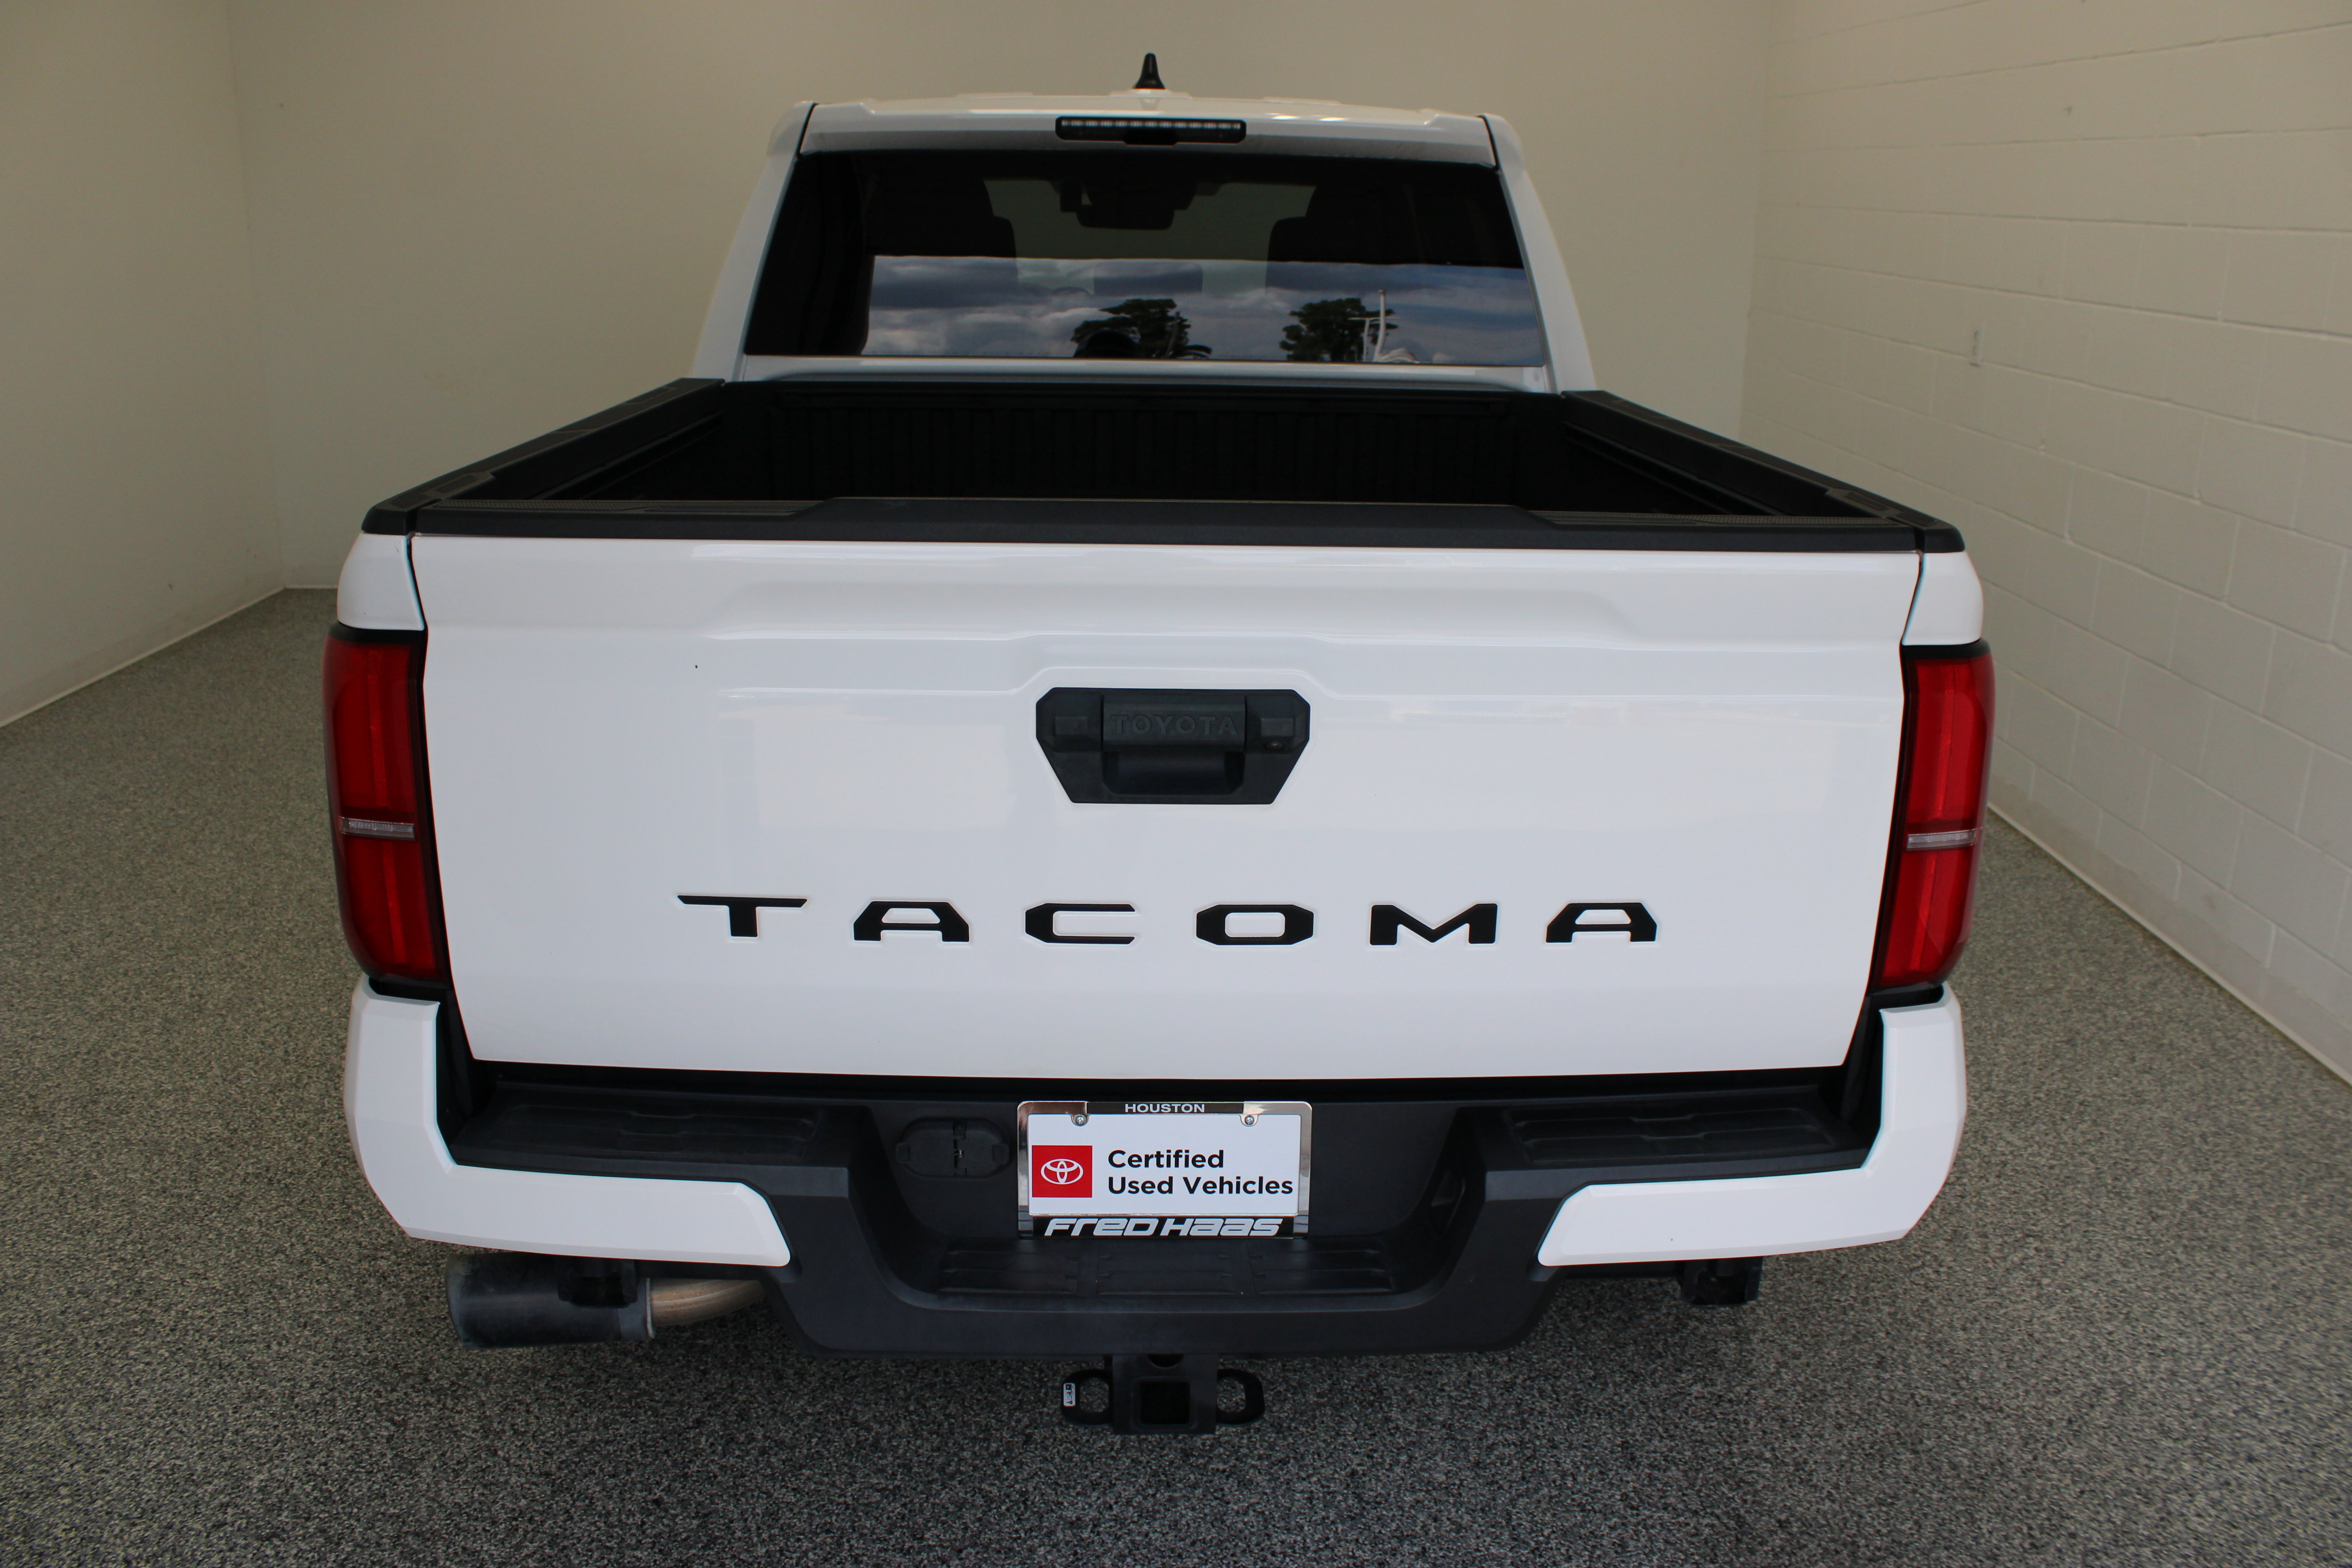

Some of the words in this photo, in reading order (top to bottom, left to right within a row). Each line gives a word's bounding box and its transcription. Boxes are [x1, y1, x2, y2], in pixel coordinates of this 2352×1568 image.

[1111, 714, 1238, 735] TOYOTA
[677, 895, 1657, 946] TACOMA
[1125, 1103, 1205, 1113] HOUSTON
[1108, 1149, 1224, 1169] Certified
[1108, 1176, 1174, 1195] Used
[1182, 1176, 1293, 1195] Vehicles
